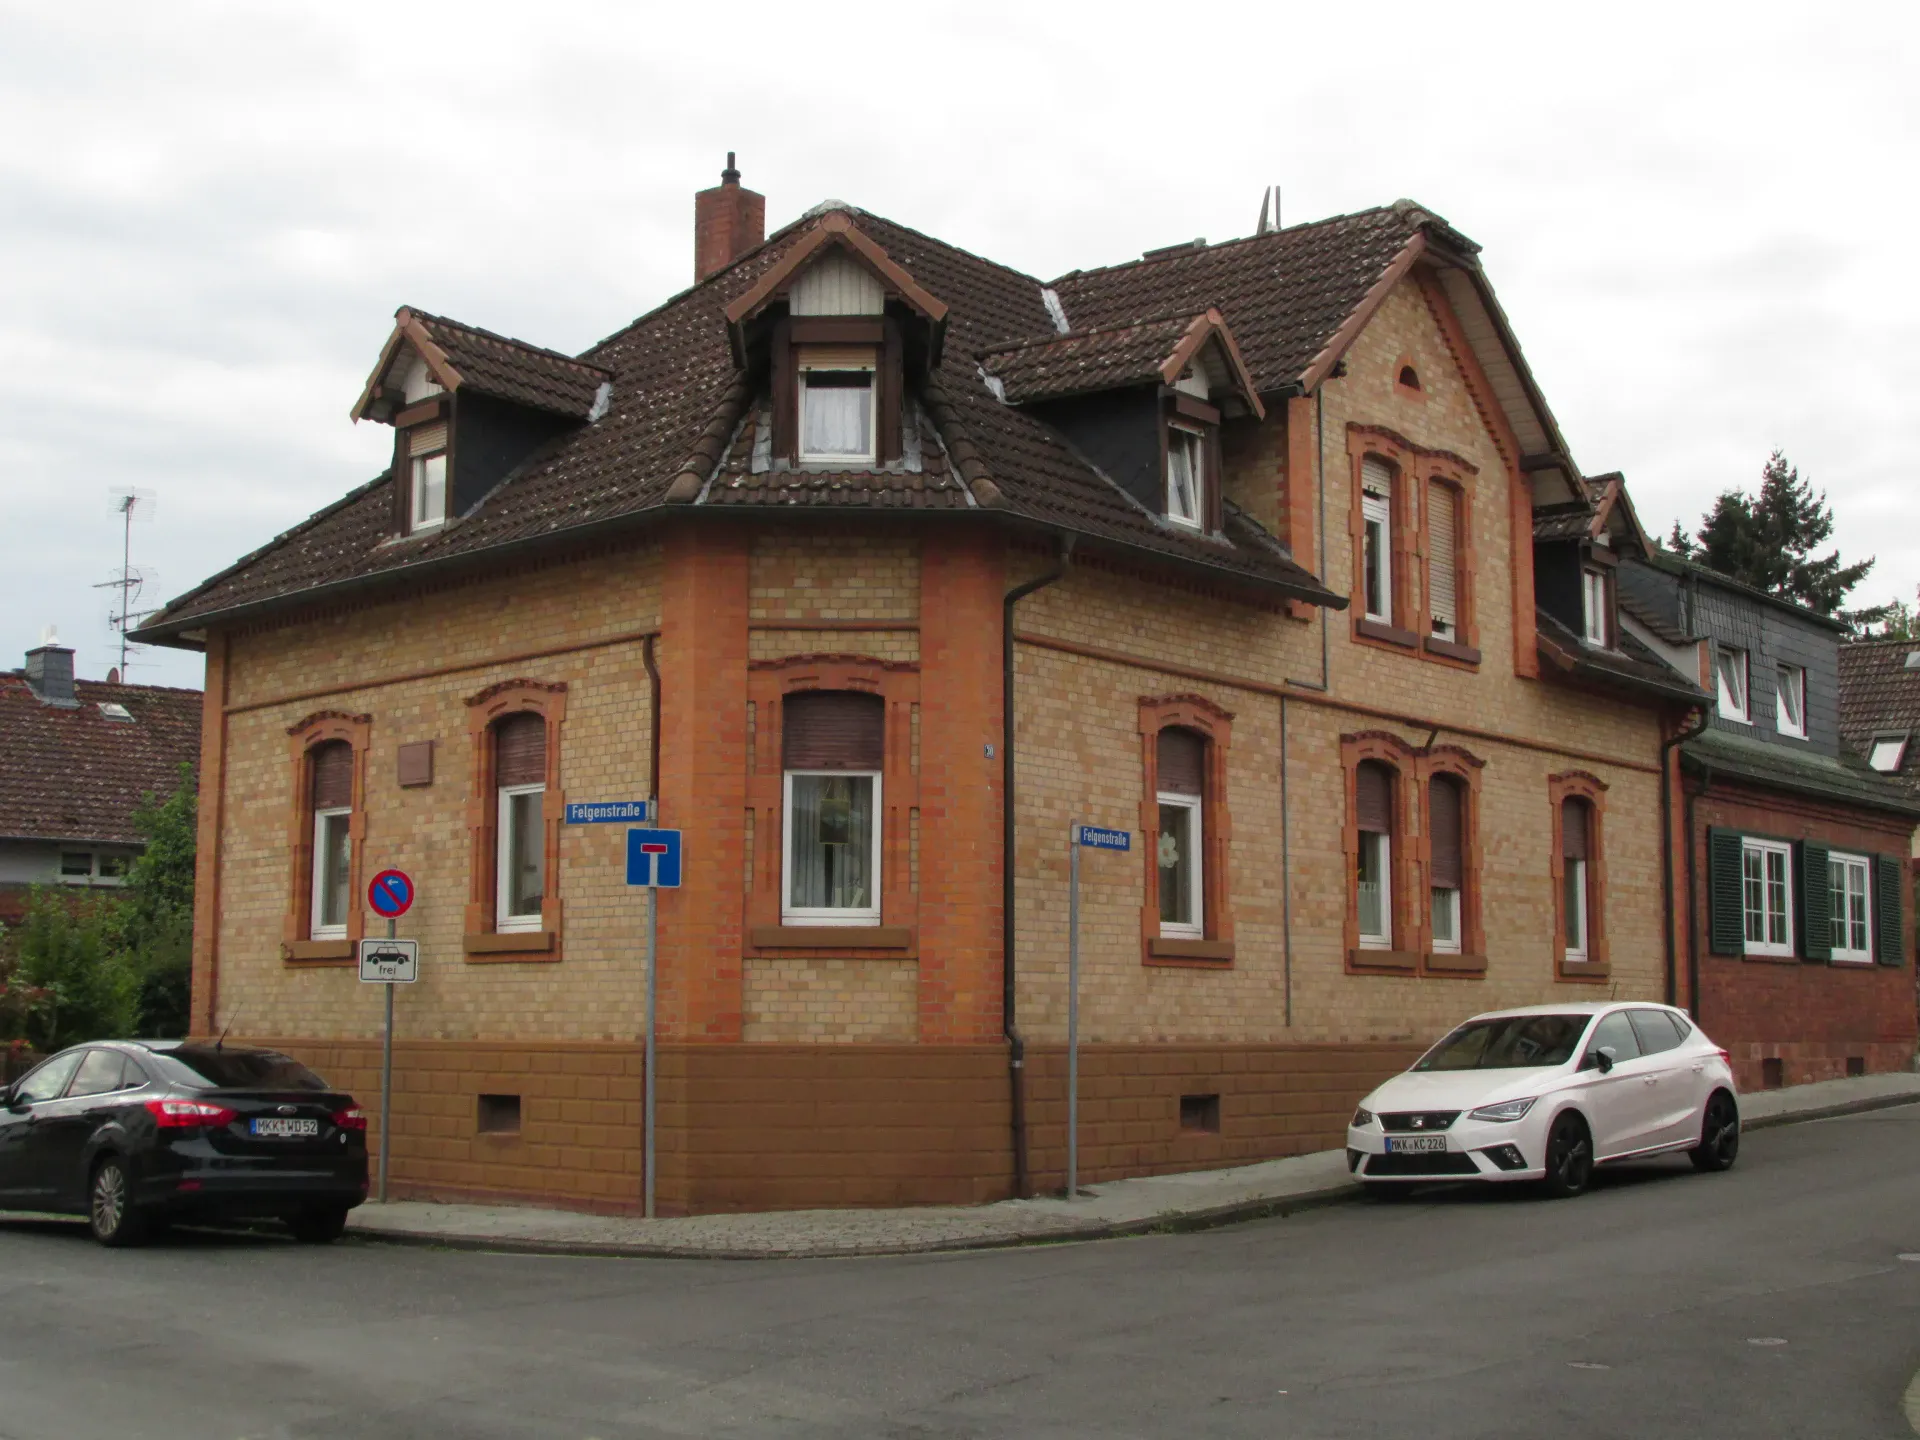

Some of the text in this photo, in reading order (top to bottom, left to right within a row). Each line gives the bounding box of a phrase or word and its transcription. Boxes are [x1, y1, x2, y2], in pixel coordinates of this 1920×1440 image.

[572, 803, 640, 821] Felgenstraße
[1083, 828, 1127, 846] Felgenstraße
[379, 965, 396, 975] frei
[257, 1120, 317, 1133] MKK WD 52
[1391, 1138, 1444, 1151] MKK KC 226
